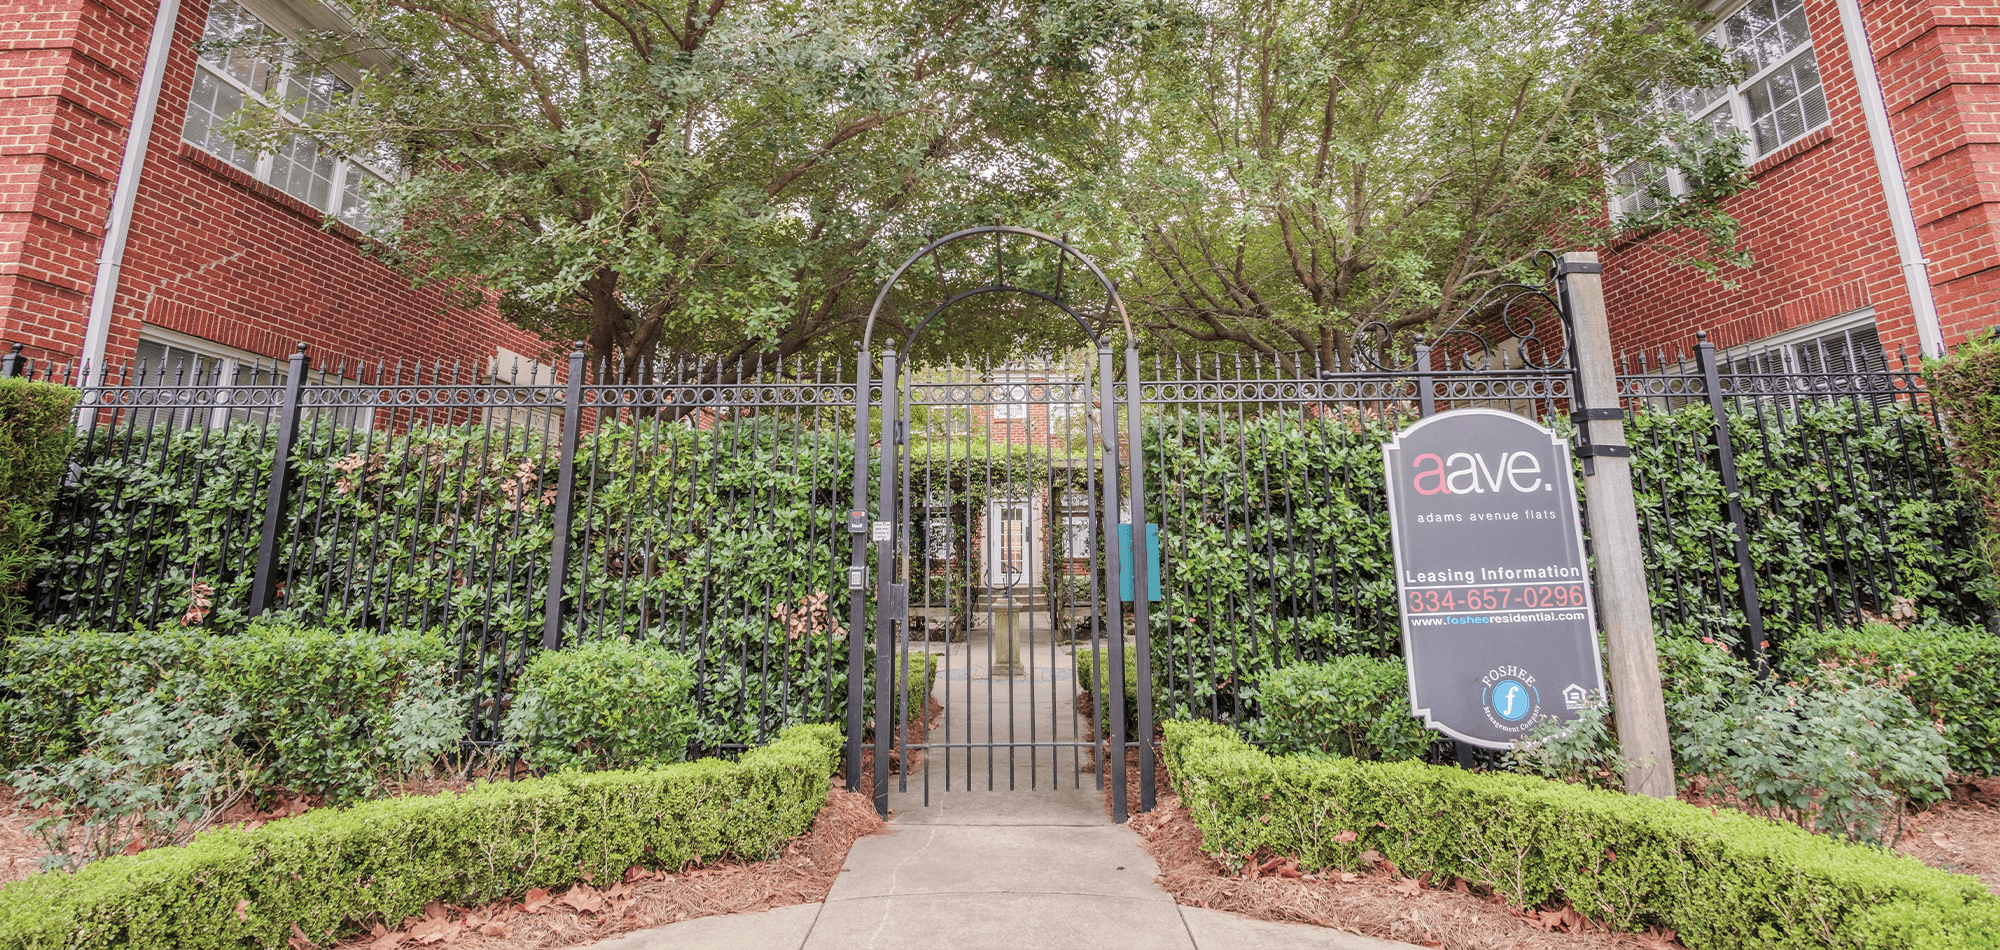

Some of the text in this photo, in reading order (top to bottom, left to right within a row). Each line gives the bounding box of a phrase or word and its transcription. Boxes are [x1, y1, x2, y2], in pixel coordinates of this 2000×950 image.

[1413, 451, 1552, 495] aave.
[1417, 509, 1556, 523] adams avenue flats
[1406, 565, 1580, 584] Leasing Information
[1409, 585, 1584, 613] 334-657-0296
[1411, 611, 1585, 626] www.fosheeresidential.com
[1482, 665, 1536, 688] FOSHEE
[1483, 704, 1541, 733] Management Company
